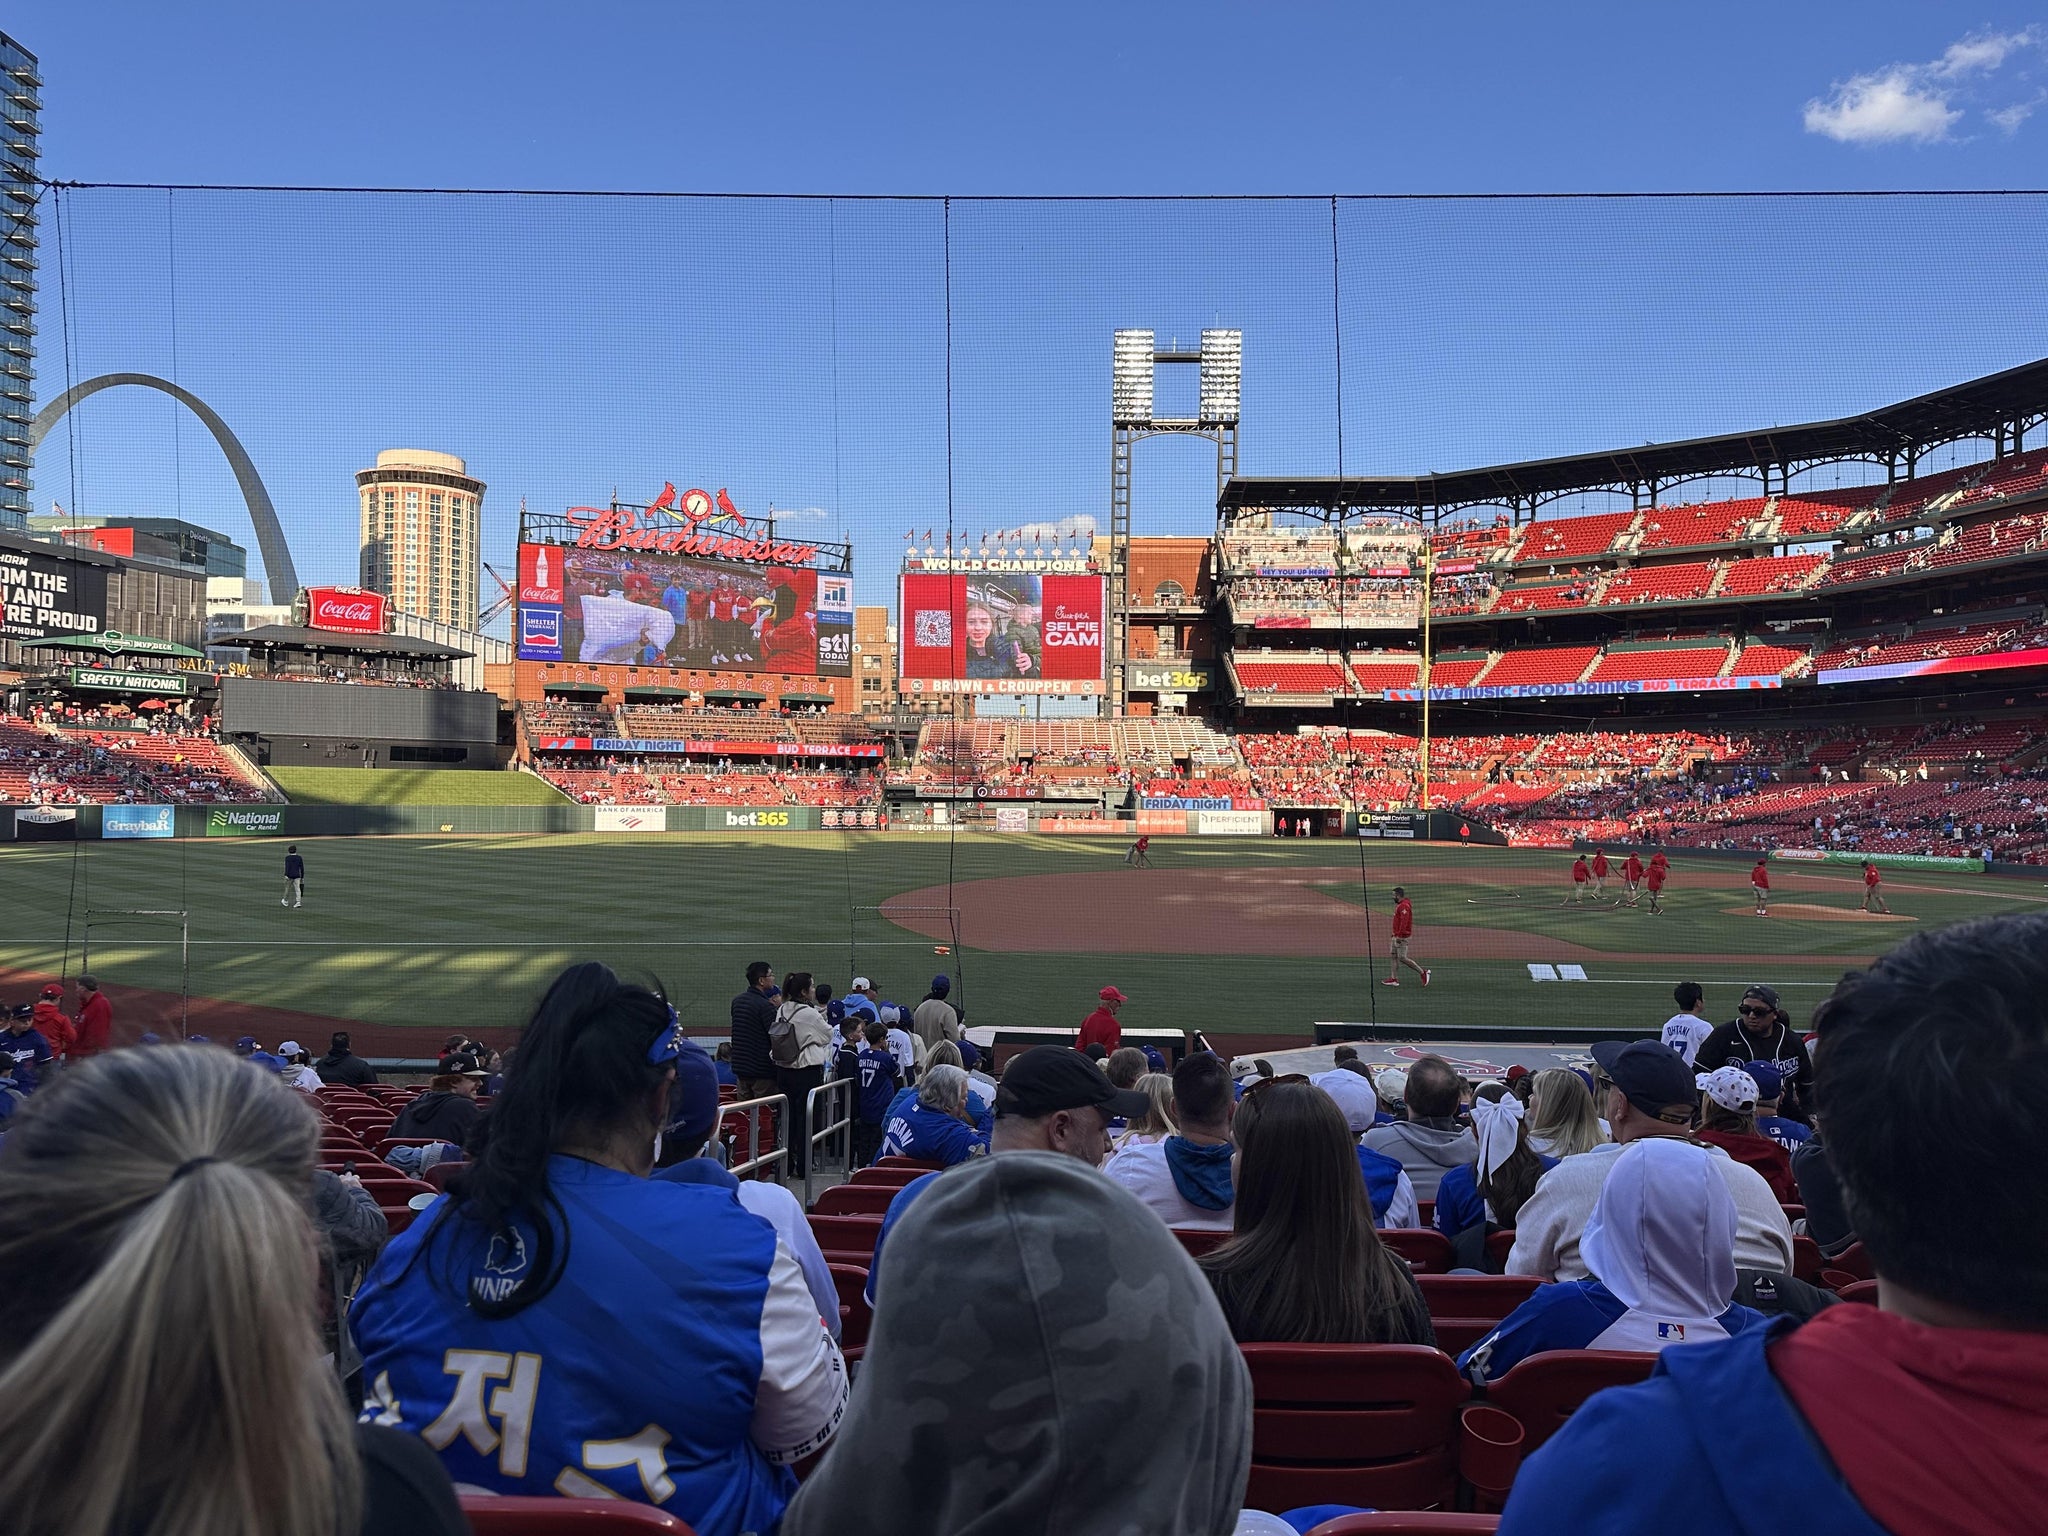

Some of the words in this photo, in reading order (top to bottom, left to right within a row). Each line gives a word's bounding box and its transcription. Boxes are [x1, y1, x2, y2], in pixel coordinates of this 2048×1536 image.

[567, 507, 816, 564] Budweiser
[921, 558, 983, 571] WORLD
[986, 559, 1087, 572] CHAMPIONS
[31, 571, 68, 593] THE
[12, 587, 54, 609] AND
[522, 587, 561, 601] Coca-Cola
[320, 600, 374, 620] Coca-Cola
[36, 608, 98, 632] PROUD
[527, 618, 555, 626] SHELTER
[1045, 621, 1099, 632] SELFIE
[819, 633, 849, 653] stl
[1045, 632, 1099, 646] CAM
[820, 652, 848, 660] TODAY
[178, 658, 214, 673] SALT
[79, 673, 124, 687] SAFETY
[125, 677, 181, 691] NATIONAL
[562, 670, 568, 683] 1
[576, 671, 584, 683] 2
[592, 671, 600, 684] 6
[609, 672, 617, 685] 9
[626, 673, 638, 685] 10
[647, 674, 660, 687] 14
[668, 675, 681, 688] 17
[689, 677, 704, 688] 20
[715, 678, 729, 690] 23
[737, 679, 752, 691] 24
[760, 680, 775, 692] 42
[782, 681, 797, 693] 45
[802, 682, 817, 694] 85
[932, 680, 983, 692] BROWN
[986, 683, 995, 692] &
[999, 680, 1071, 692] CROUPPEN
[1135, 670, 1208, 688] bet365
[1460, 687, 1512, 699] MUSIC
[1519, 684, 1567, 697] FOOD
[1574, 682, 1639, 695] DRINKS
[1643, 680, 1670, 691] BUD
[1674, 678, 1736, 689] TERRACE
[596, 740, 640, 750] FRIDAY
[644, 741, 681, 751] NIGHT
[689, 741, 714, 752] LIVE
[777, 745, 799, 754] BUD
[803, 746, 850, 755] TERRACE
[1145, 800, 1188, 809] FRIDAY
[1193, 800, 1229, 809] NIGHT
[1236, 800, 1260, 810] LIVE
[228, 812, 280, 824] National
[726, 811, 789, 826] bet365
[1067, 821, 1113, 830] Budweiser
[106, 820, 168, 833] GraybaR
[1782, 850, 1817, 858] SERVPRO
[1837, 851, 1867, 860] Cleaning
[1869, 853, 1914, 861] Restoration
[1916, 855, 1967, 864] Construction
[1667, 1025, 1690, 1037] OHTANI
[858, 1059, 880, 1070] OHTANI
[861, 1069, 875, 1087] 17
[887, 1117, 914, 1148] OHTANI
